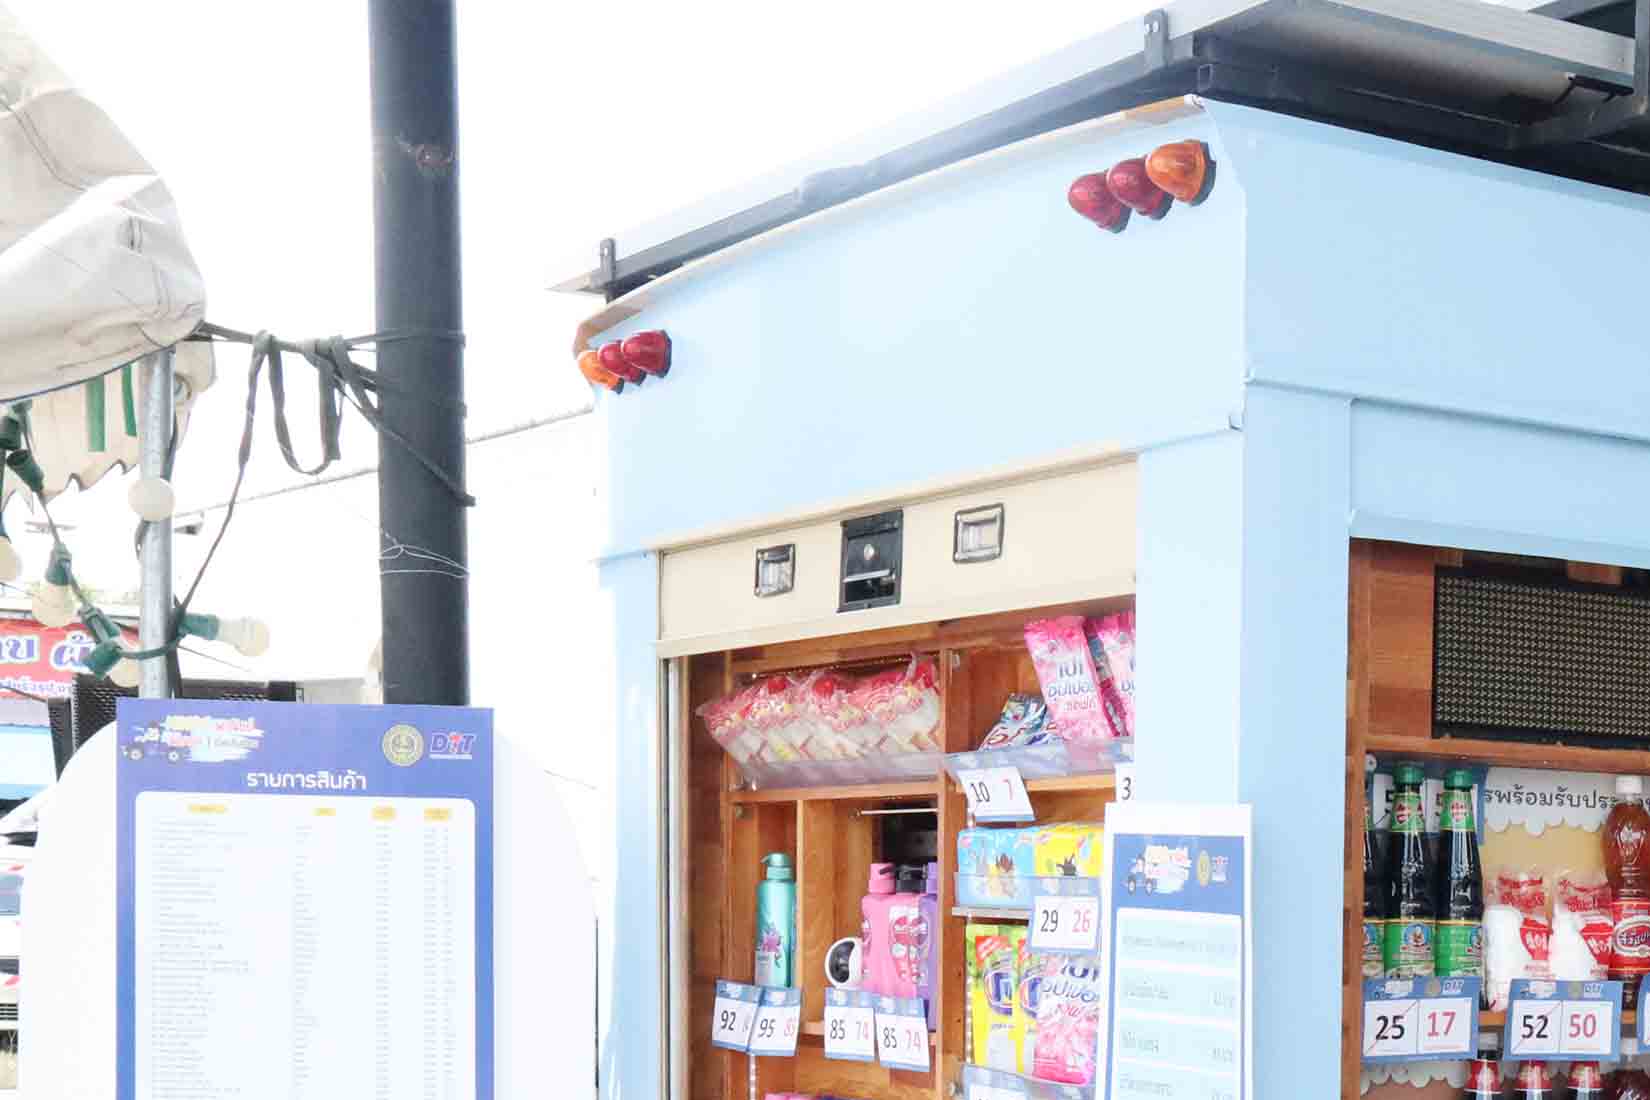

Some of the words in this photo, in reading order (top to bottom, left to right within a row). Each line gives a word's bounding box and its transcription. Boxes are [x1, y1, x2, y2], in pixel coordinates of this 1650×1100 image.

[247, 769, 367, 791] รายการสินค้า
[970, 781, 991, 803] 10
[1040, 909, 1059, 933] 29
[1072, 909, 1092, 933] 26
[720, 1010, 737, 1031] 92
[757, 1018, 777, 1038] 95
[830, 1019, 846, 1040] 85
[1375, 1014, 1405, 1041] 25
[1427, 1011, 1457, 1038] 17
[1520, 1014, 1549, 1040] 52
[1568, 1013, 1597, 1039] 50
